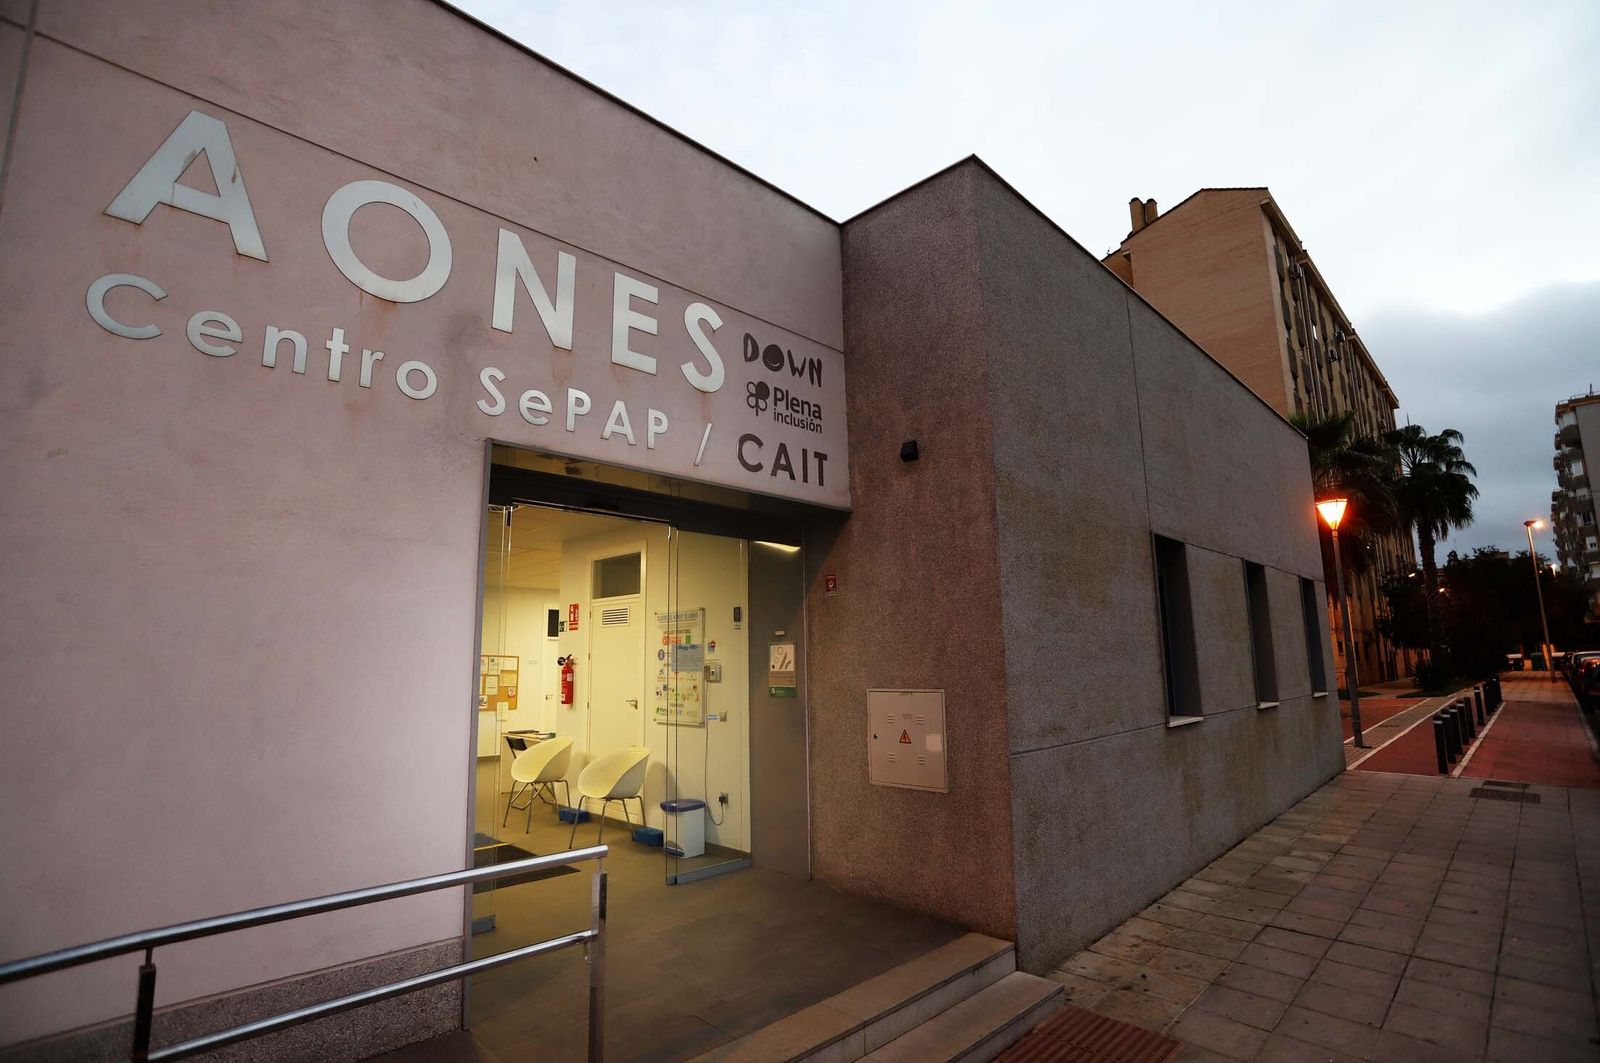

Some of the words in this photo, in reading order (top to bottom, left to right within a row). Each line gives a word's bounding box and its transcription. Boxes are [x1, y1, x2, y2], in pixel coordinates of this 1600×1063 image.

[103, 110, 725, 393] AONES
[86, 273, 437, 399] Centro
[476, 366, 669, 450] SePAP
[693, 422, 713, 466] /
[737, 433, 828, 487] CAIT
[743, 332, 822, 387] DOWN
[773, 386, 822, 421] Plena
[773, 408, 823, 434] inclusión
